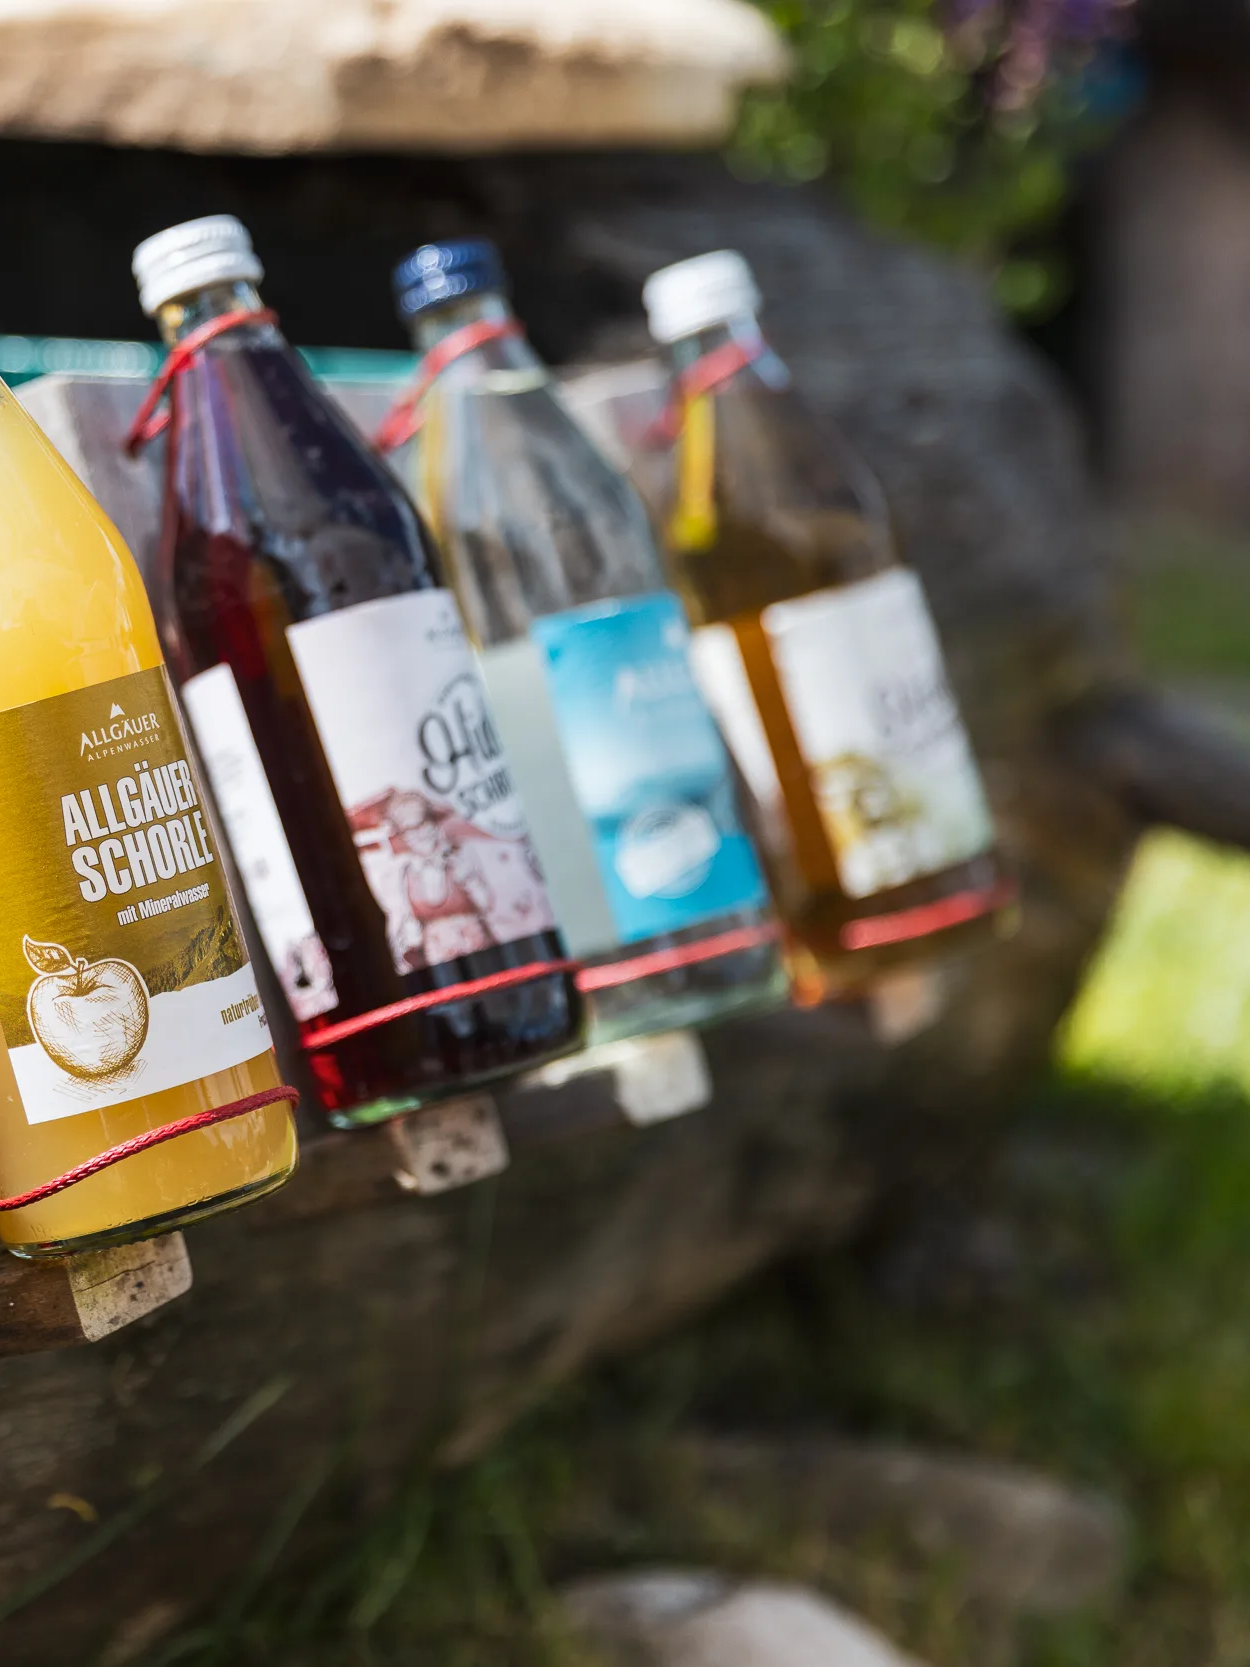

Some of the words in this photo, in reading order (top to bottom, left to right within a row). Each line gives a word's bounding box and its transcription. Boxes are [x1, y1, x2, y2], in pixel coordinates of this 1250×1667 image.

[80, 713, 160, 757] ALLGÄUER
[88, 733, 160, 762] ALPENWASSER
[60, 759, 199, 847] ALLGÄUER
[71, 810, 215, 902] SCHORLE
[116, 904, 139, 927] mit
[138, 882, 211, 919] Mineralwasser
